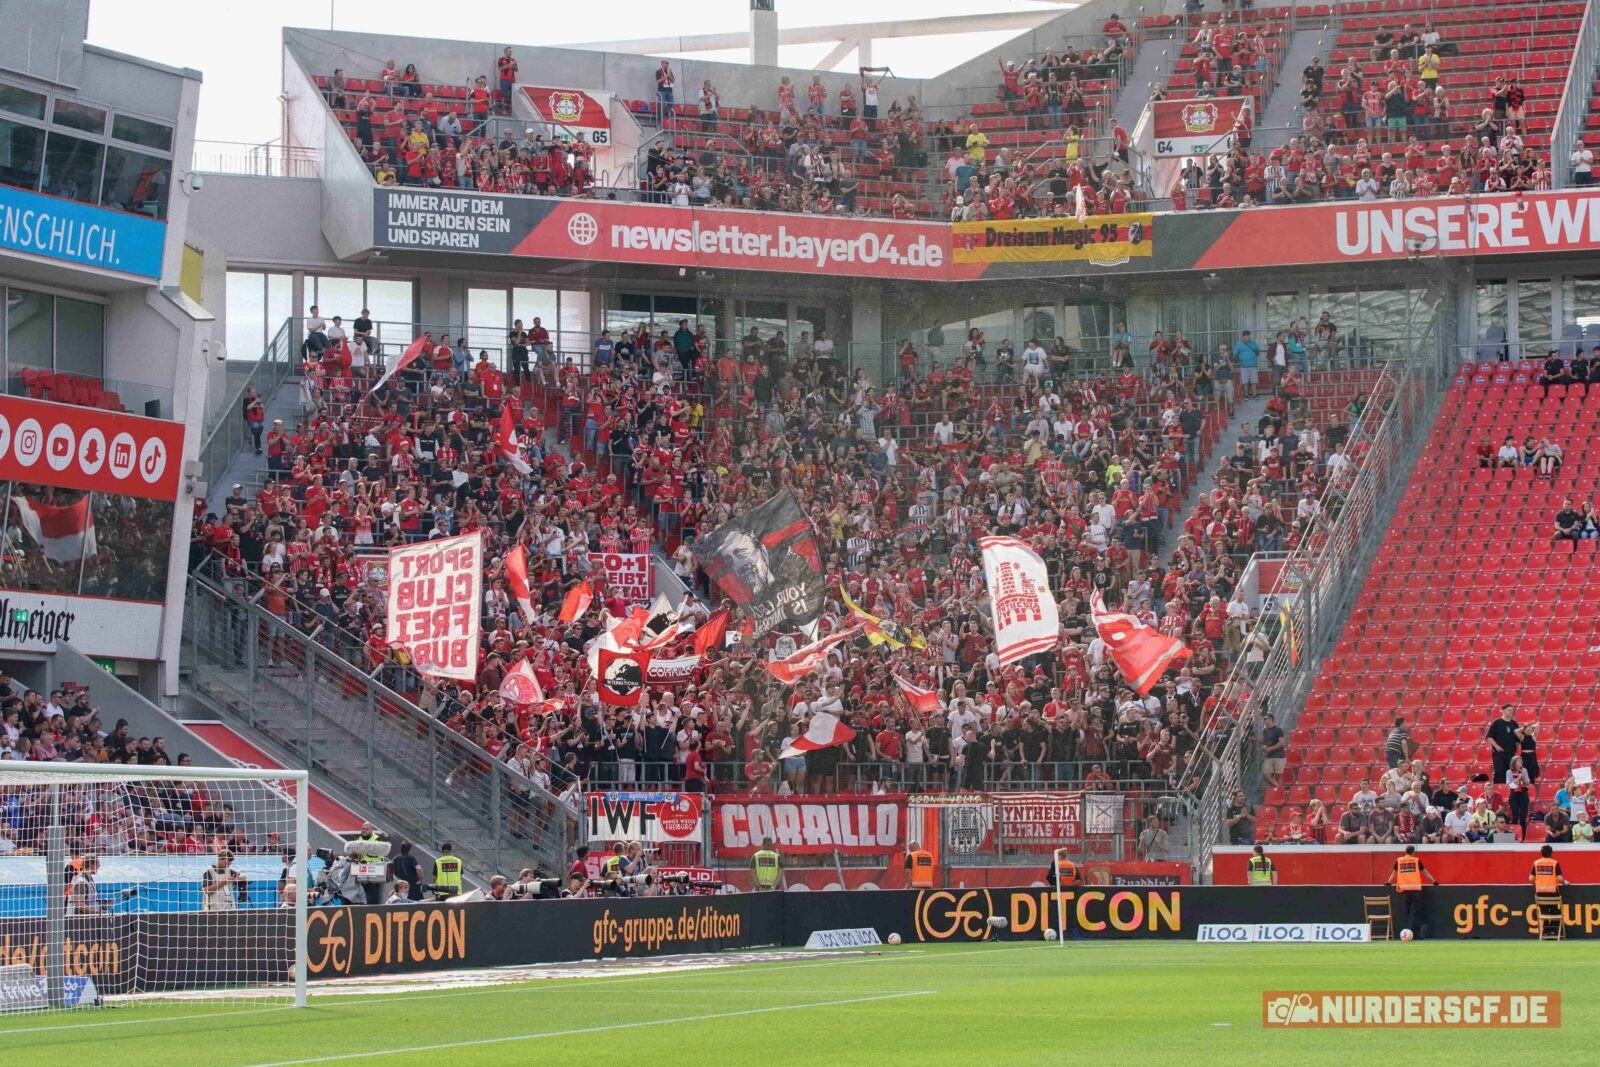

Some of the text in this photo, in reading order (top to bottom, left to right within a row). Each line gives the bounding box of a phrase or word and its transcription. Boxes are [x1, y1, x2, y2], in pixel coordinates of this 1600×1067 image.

[592, 131, 608, 143] G5
[1157, 140, 1174, 154] G4
[388, 193, 504, 216] IMMER AUF DEM
[388, 212, 511, 233] LAUFENDEN SEIN
[1335, 201, 1531, 256] UNSERE
[388, 229, 480, 249] UND SPAREN
[611, 219, 943, 268] newsletter.bayer04.de
[985, 223, 1118, 250] Dreisam Magic 95
[608, 572, 648, 586] EIBT.
[720, 803, 899, 848] CORRILLO
[1010, 890, 1181, 933] DITCON
[1453, 894, 1600, 934] gfc-gup
[365, 908, 466, 965] DITCON
[593, 905, 740, 953] gfc-gruppe.de/ditcon
[1201, 926, 1249, 941] iLOQ
[1258, 925, 1305, 940] iLOQ
[1315, 925, 1363, 941] iLOQ
